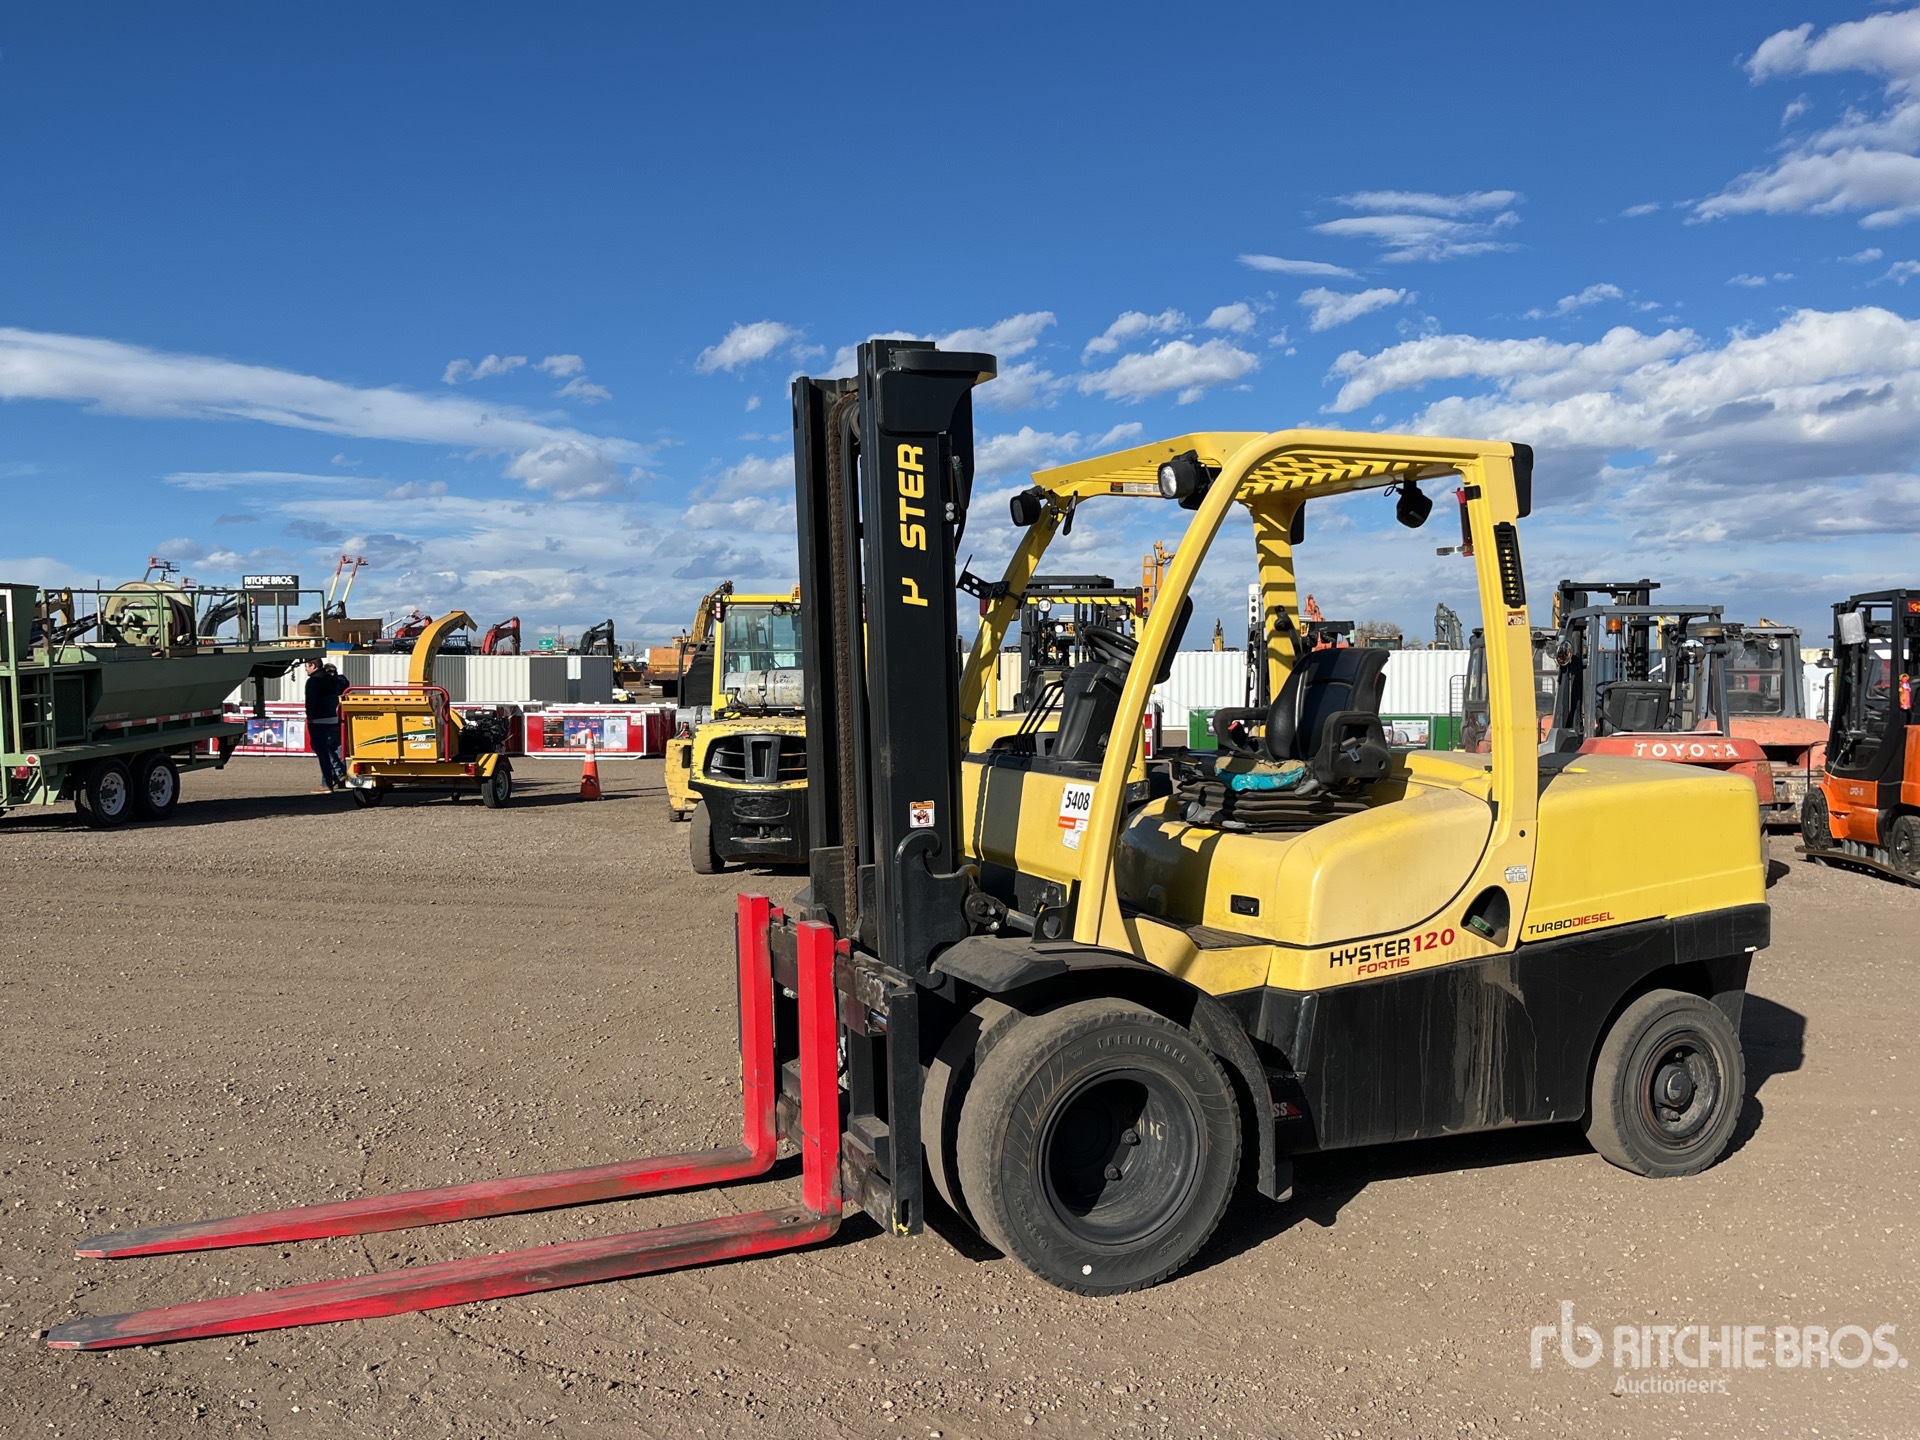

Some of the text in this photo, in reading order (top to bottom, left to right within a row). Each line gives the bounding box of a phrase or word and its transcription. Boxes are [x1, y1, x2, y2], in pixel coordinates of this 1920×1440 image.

[897, 443, 929, 607] HSTER
[244, 576, 270, 585] RITCHIE
[1634, 743, 1740, 757] TOYOTA
[1065, 790, 1090, 811] 5408
[1528, 911, 1615, 934] TURBODIESEL
[1330, 928, 1455, 968] HYSTER 120
[1357, 956, 1410, 975] FORTIS
[1097, 1034, 1189, 1065] TRELLEBORG
